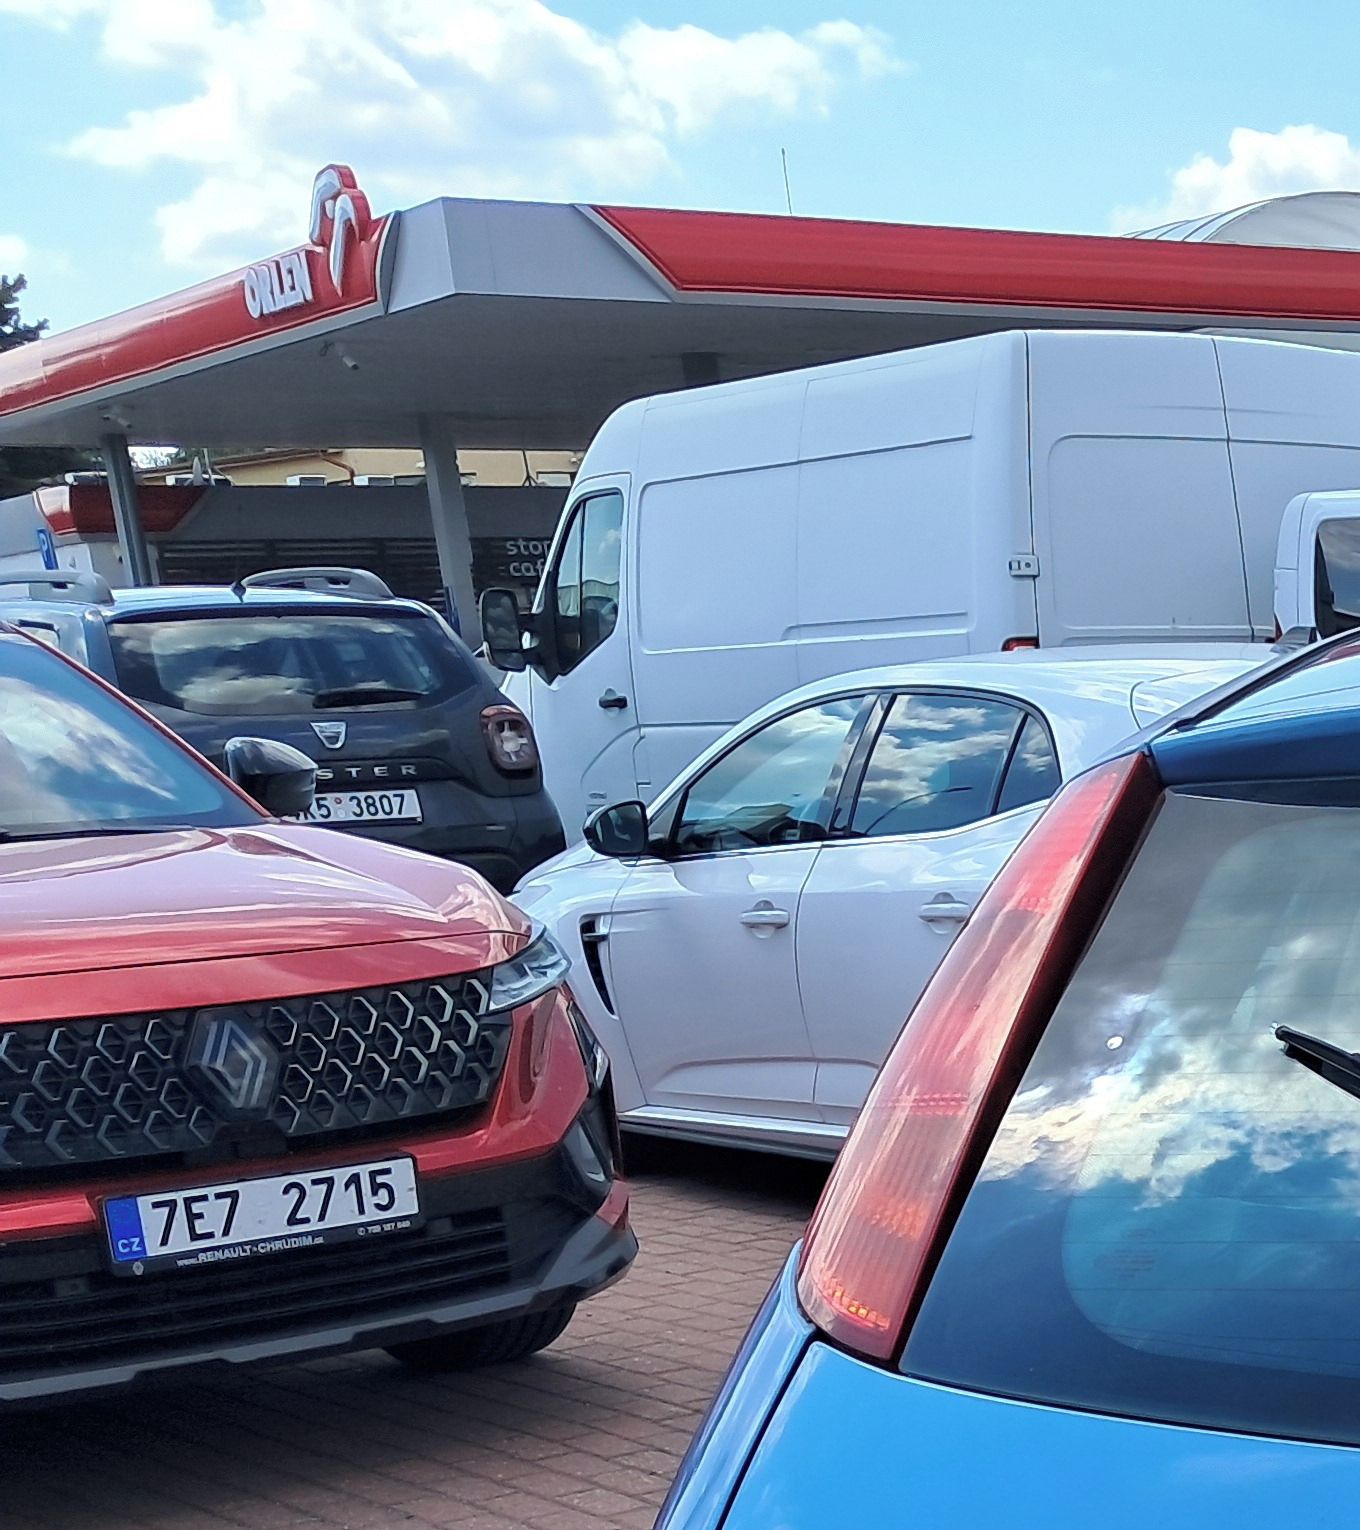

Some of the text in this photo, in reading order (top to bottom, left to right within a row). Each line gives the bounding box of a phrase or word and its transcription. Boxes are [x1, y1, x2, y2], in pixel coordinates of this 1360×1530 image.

[244, 250, 313, 319] ORLEN
[350, 793, 405, 818] 3807
[151, 1167, 396, 1247] 7E7 2715
[118, 1237, 142, 1253] CZ
